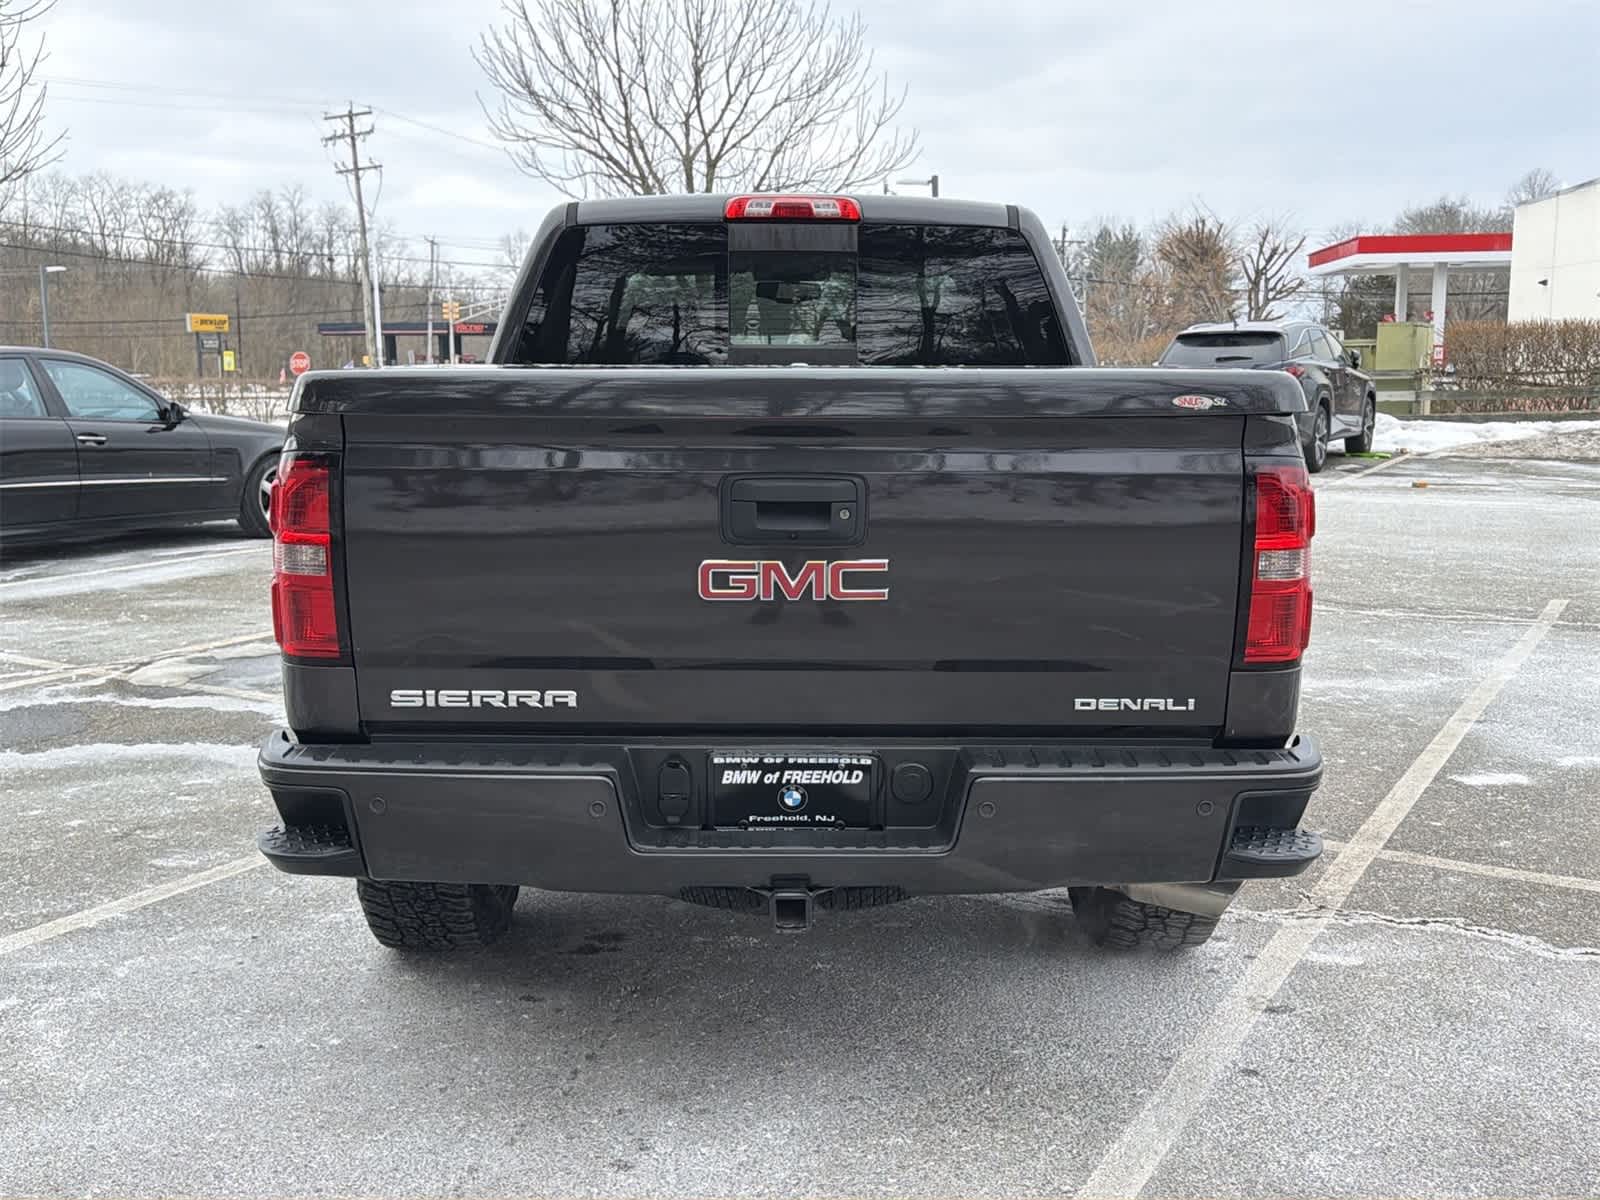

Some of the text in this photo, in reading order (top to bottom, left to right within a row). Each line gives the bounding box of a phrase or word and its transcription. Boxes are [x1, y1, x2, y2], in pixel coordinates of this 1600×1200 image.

[291, 358, 308, 369] STOP
[698, 559, 889, 600] GMC
[390, 690, 577, 708] SIERRA
[1074, 698, 1195, 711] DENALI
[788, 757, 872, 765] FREEHOLD
[722, 770, 863, 784] BMW of FREEHOLD
